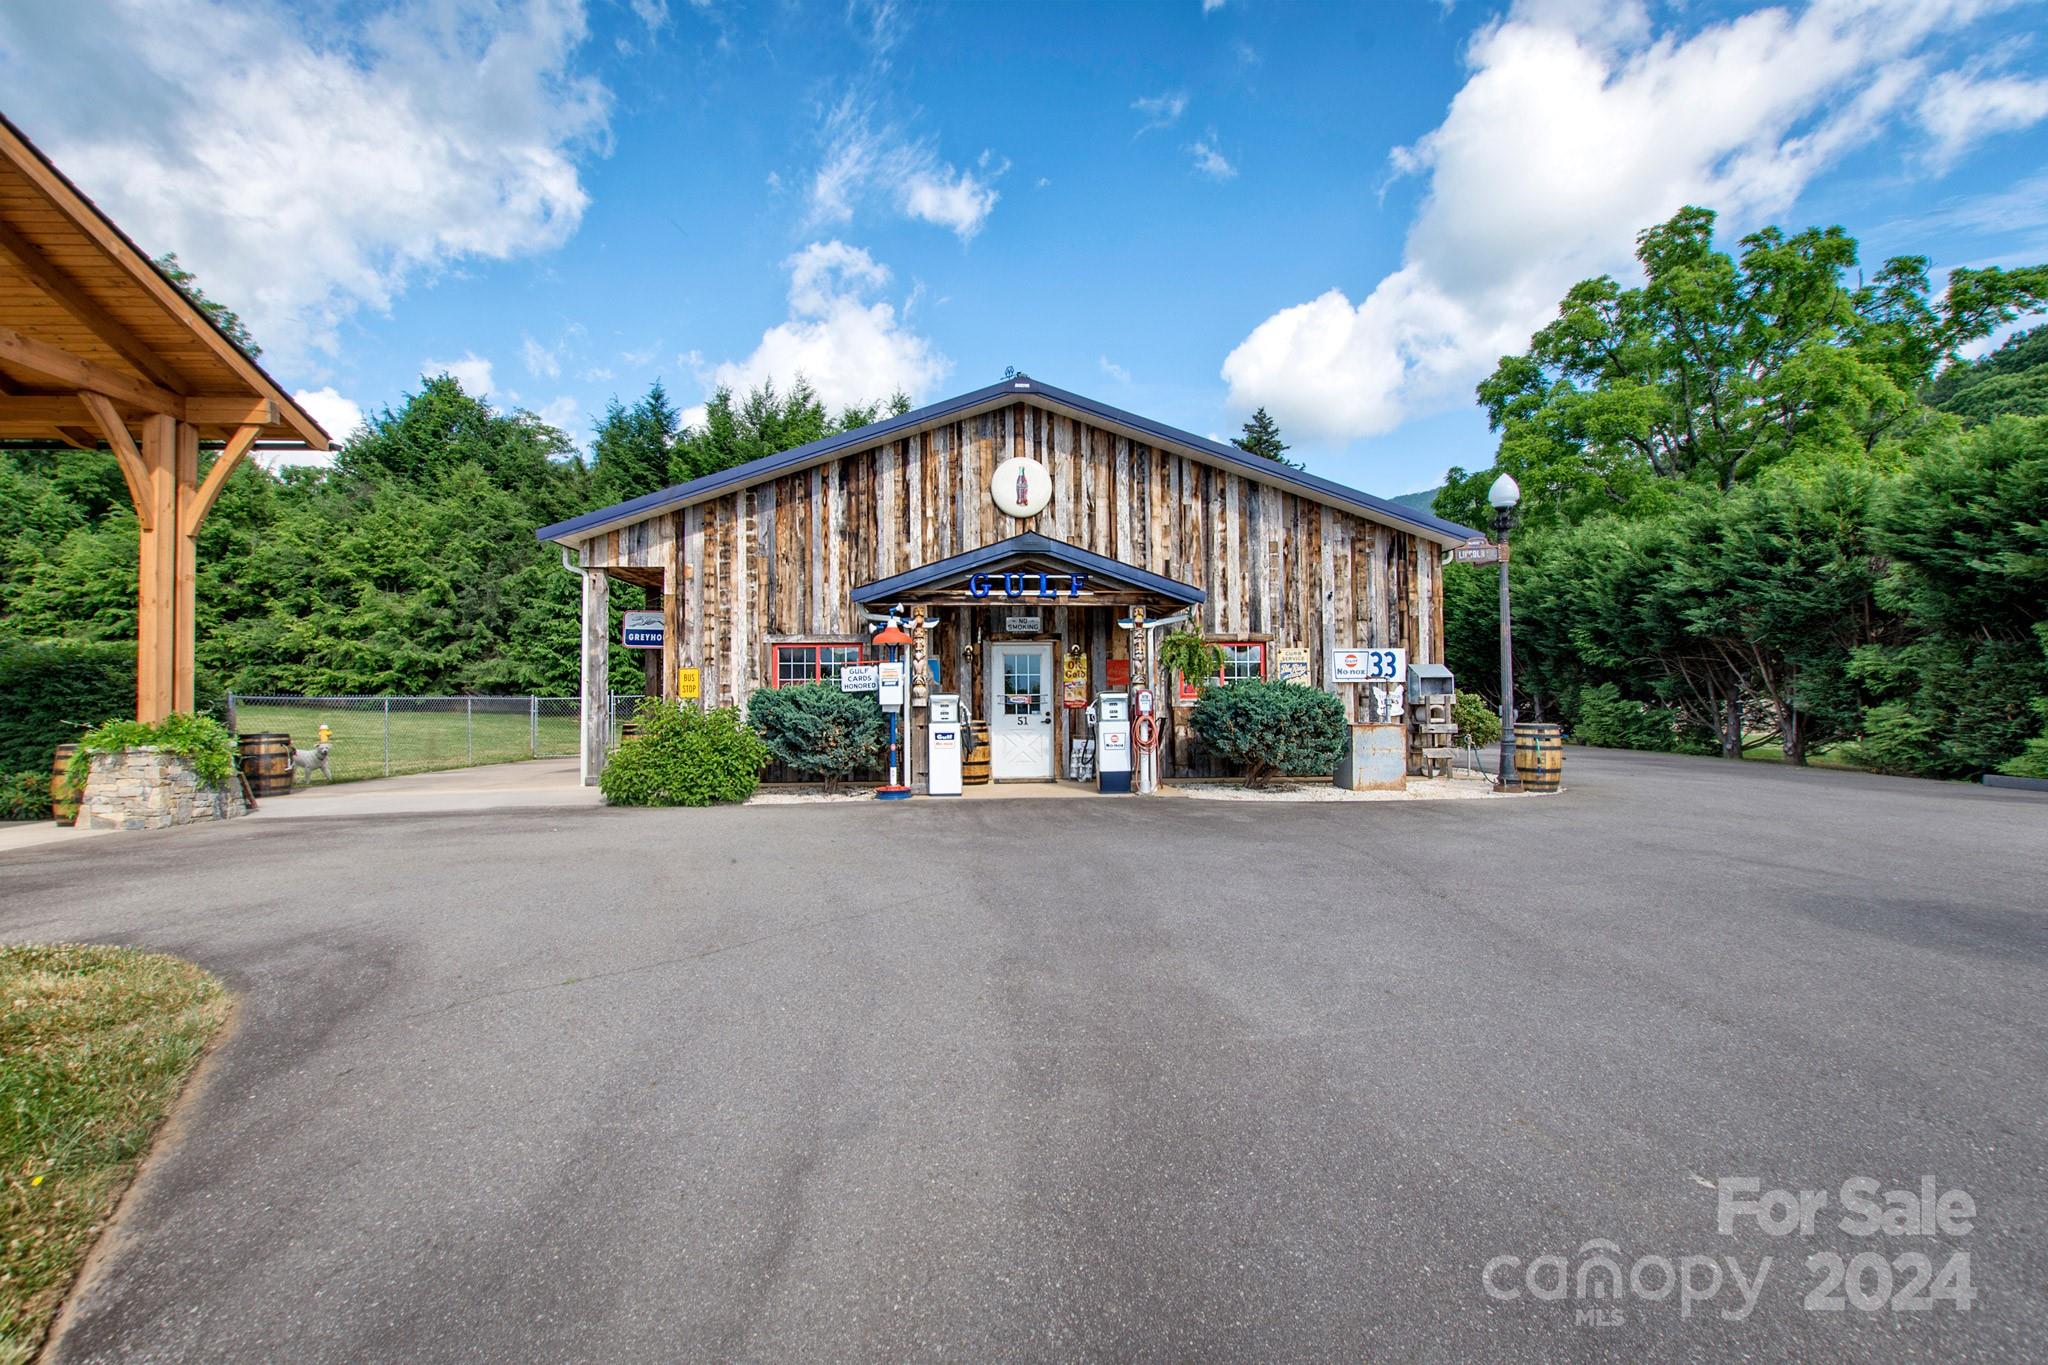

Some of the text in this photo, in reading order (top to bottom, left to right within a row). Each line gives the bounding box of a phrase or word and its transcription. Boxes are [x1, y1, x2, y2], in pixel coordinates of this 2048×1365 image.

[969, 572, 1088, 599] GULF
[628, 633, 663, 641] GREYHO
[1370, 651, 1397, 678] 33
[683, 674, 695, 682] BUS
[1065, 670, 1086, 679] Gold
[682, 685, 697, 693] STOP
[844, 682, 877, 690] HONORED
[1017, 716, 1029, 726] 51
